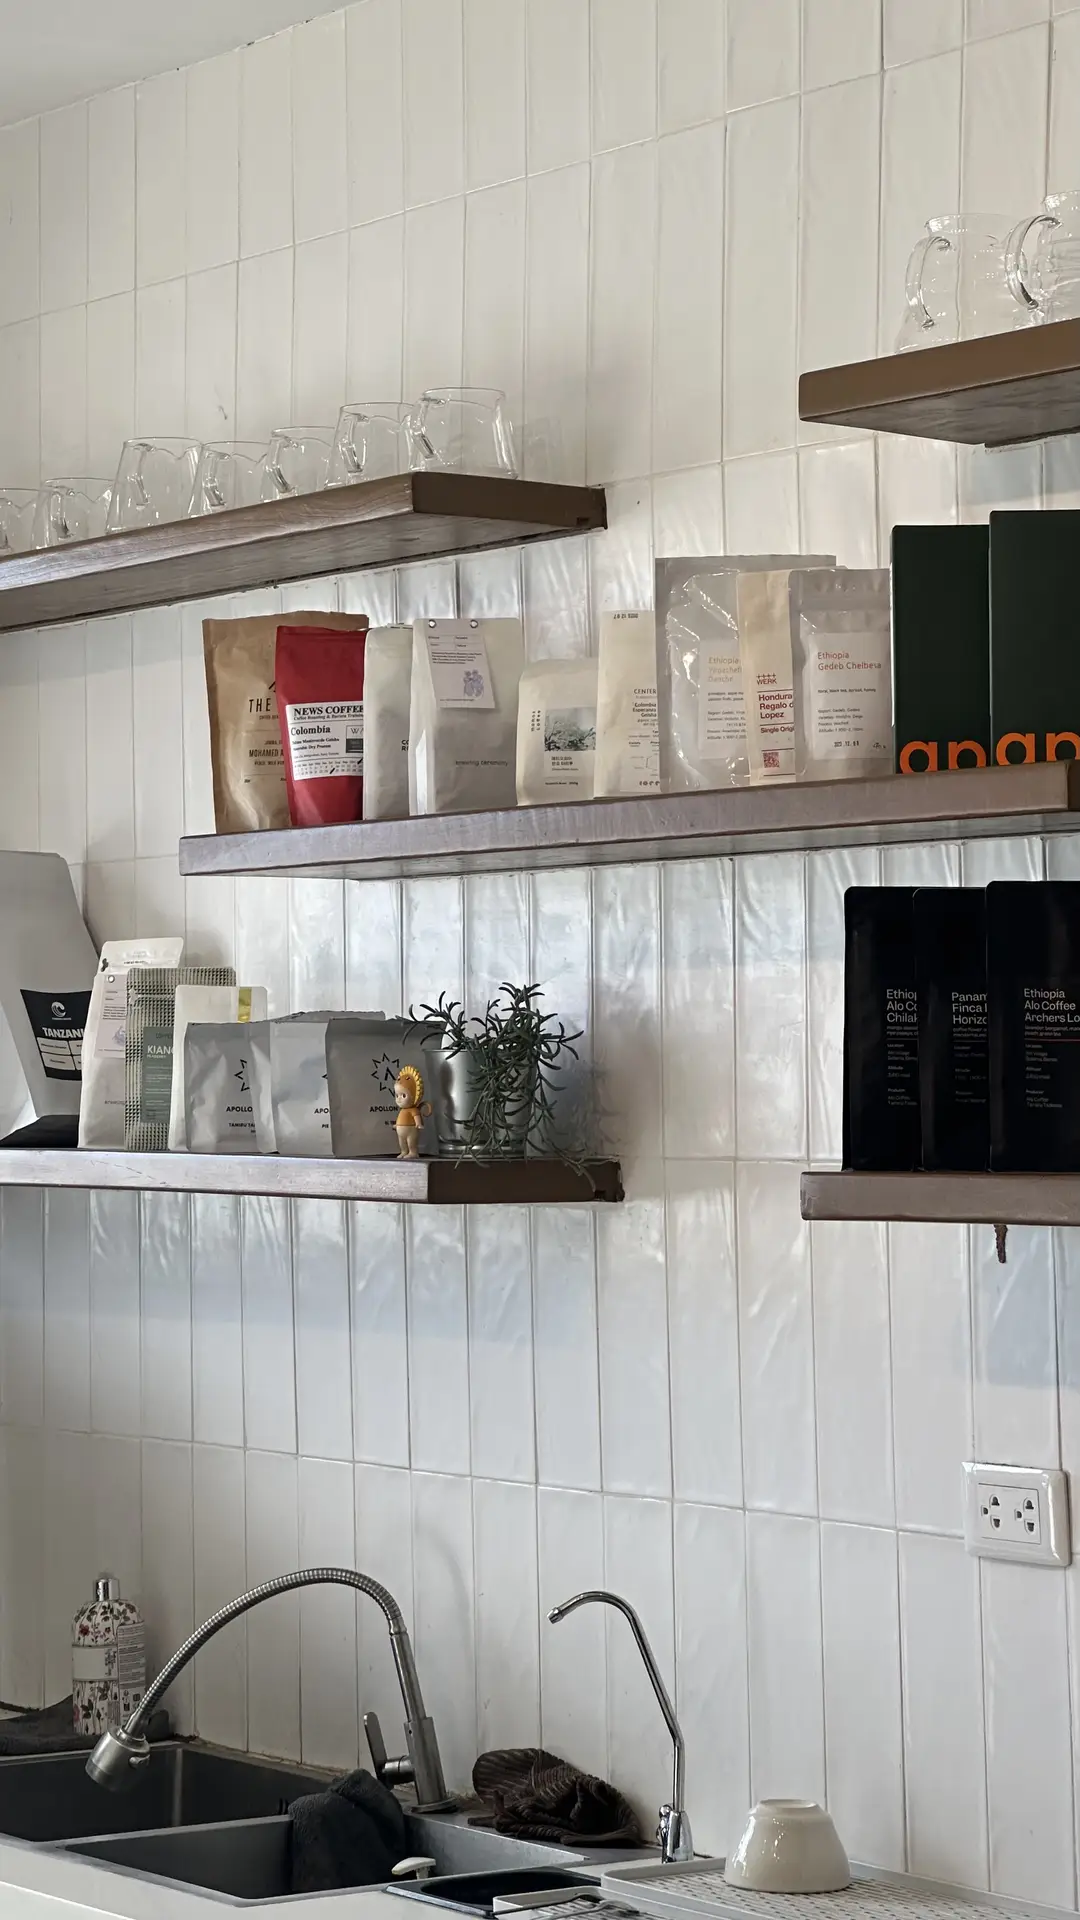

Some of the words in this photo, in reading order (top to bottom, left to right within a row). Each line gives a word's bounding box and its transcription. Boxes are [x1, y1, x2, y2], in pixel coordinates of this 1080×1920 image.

[708, 656, 739, 664] Ethiopia
[817, 652, 849, 660] Ethiopia
[818, 663, 844, 671] Gedeb
[758, 693, 792, 701] Hondura
[249, 698, 271, 713] THE
[760, 702, 788, 711] Regalo
[294, 706, 323, 716] NEWS
[291, 725, 331, 736] Colombia
[249, 749, 278, 757] MOHAMED
[1024, 988, 1065, 1000] Ethiopia
[887, 1001, 904, 1011] Alo
[952, 1003, 982, 1013] Finca
[1024, 1000, 1040, 1010] Alo
[1041, 1000, 1076, 1011] Coffee
[1024, 1012, 1066, 1023] Archers
